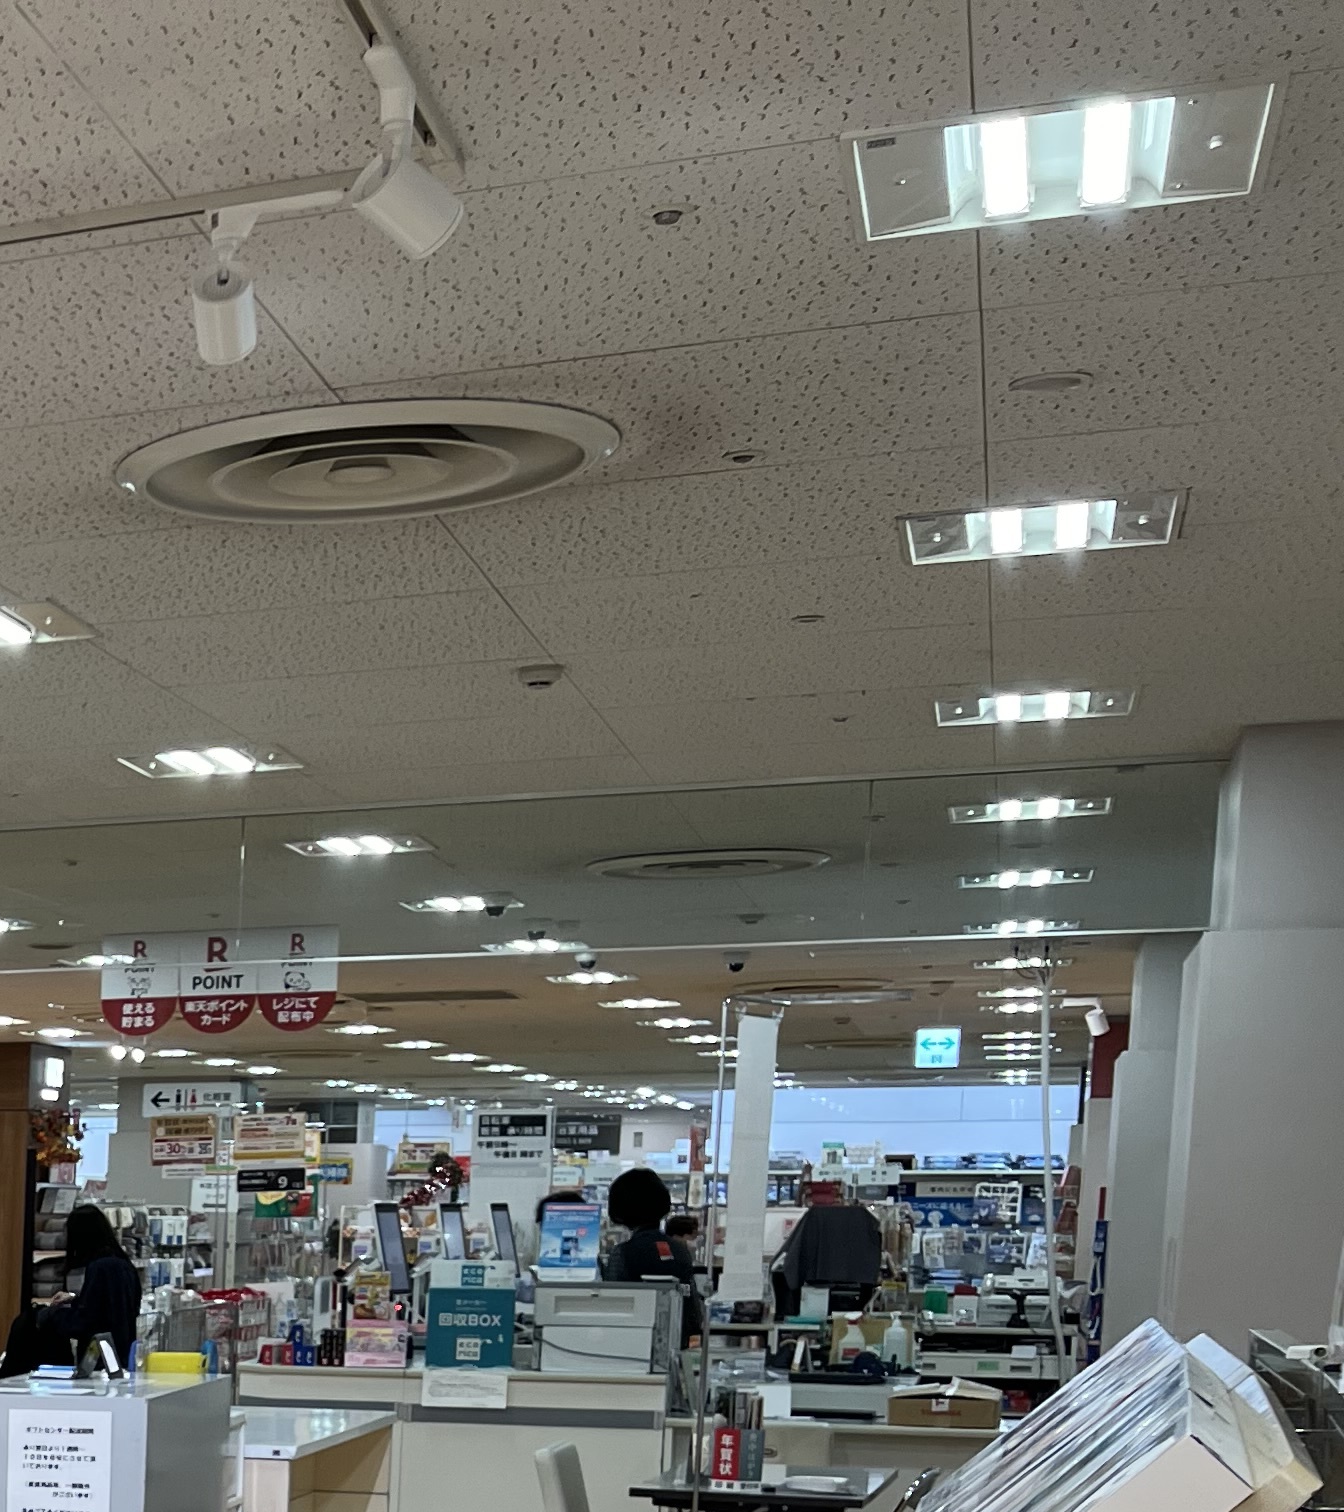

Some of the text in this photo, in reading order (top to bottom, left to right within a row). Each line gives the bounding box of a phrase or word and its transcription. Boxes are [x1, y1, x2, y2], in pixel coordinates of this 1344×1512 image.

[133, 940, 147, 958] R
[207, 936, 228, 963] R
[290, 933, 305, 951] R
[192, 974, 244, 990] POINT
[122, 1002, 155, 1015] 使える
[184, 999, 248, 1013] 楽天ポイント
[272, 996, 319, 1011] レジにて
[121, 1015, 155, 1028] 貯まる
[201, 1014, 231, 1026] カード
[277, 1011, 314, 1024] 配布中
[718, 1433, 736, 1477] 年賀状
